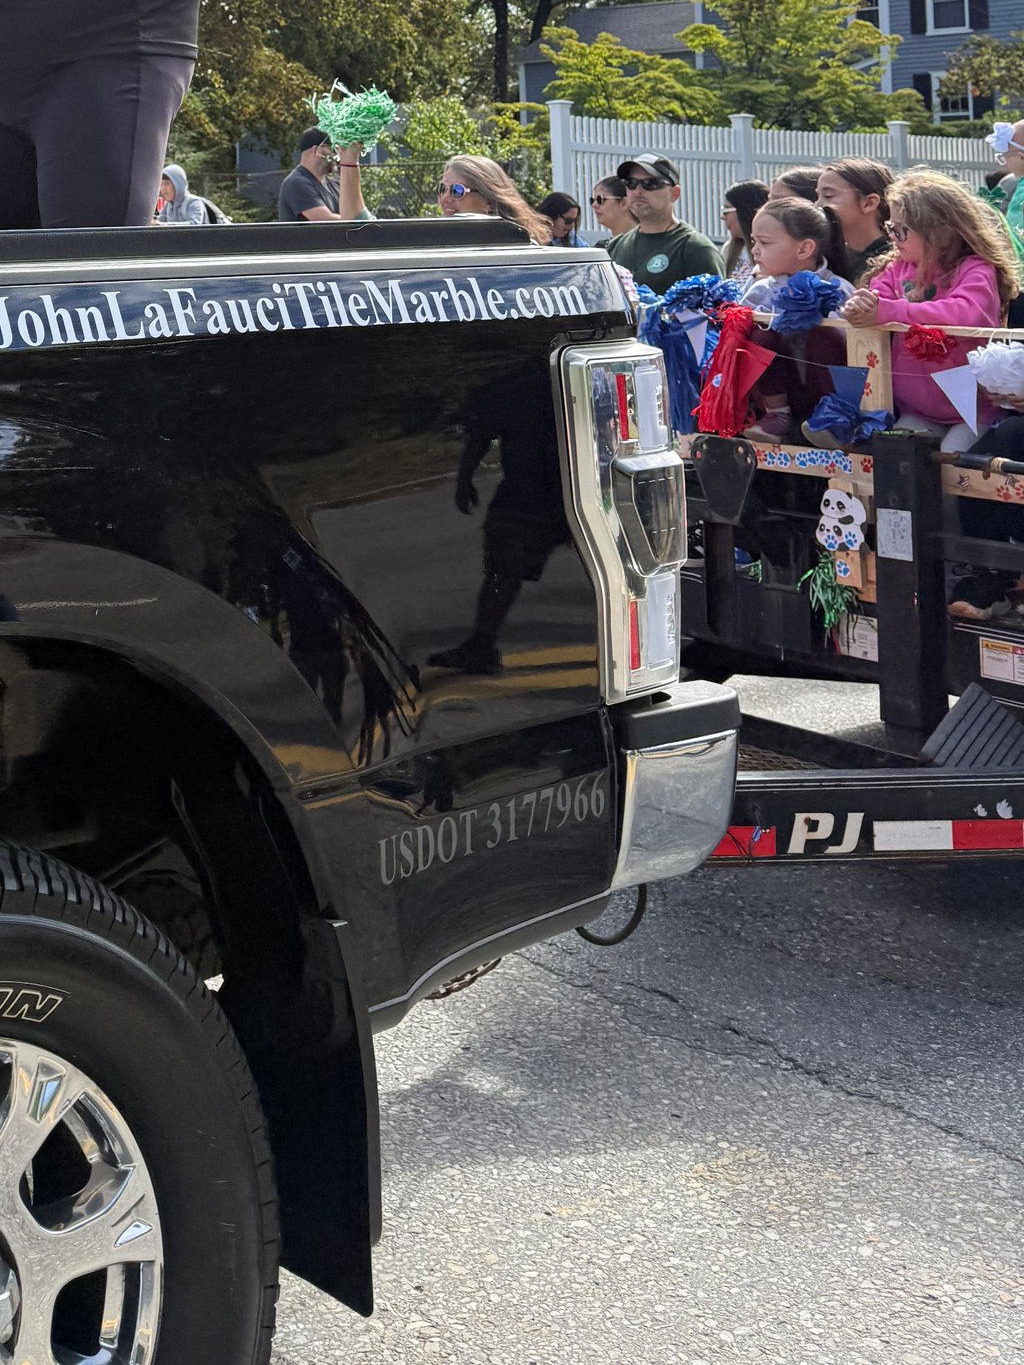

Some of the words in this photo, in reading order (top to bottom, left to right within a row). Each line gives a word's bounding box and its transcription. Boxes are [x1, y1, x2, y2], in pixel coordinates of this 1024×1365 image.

[378, 809, 478, 885] USDOT
[486, 772, 605, 849] 3177966
[787, 812, 865, 854] PJ
